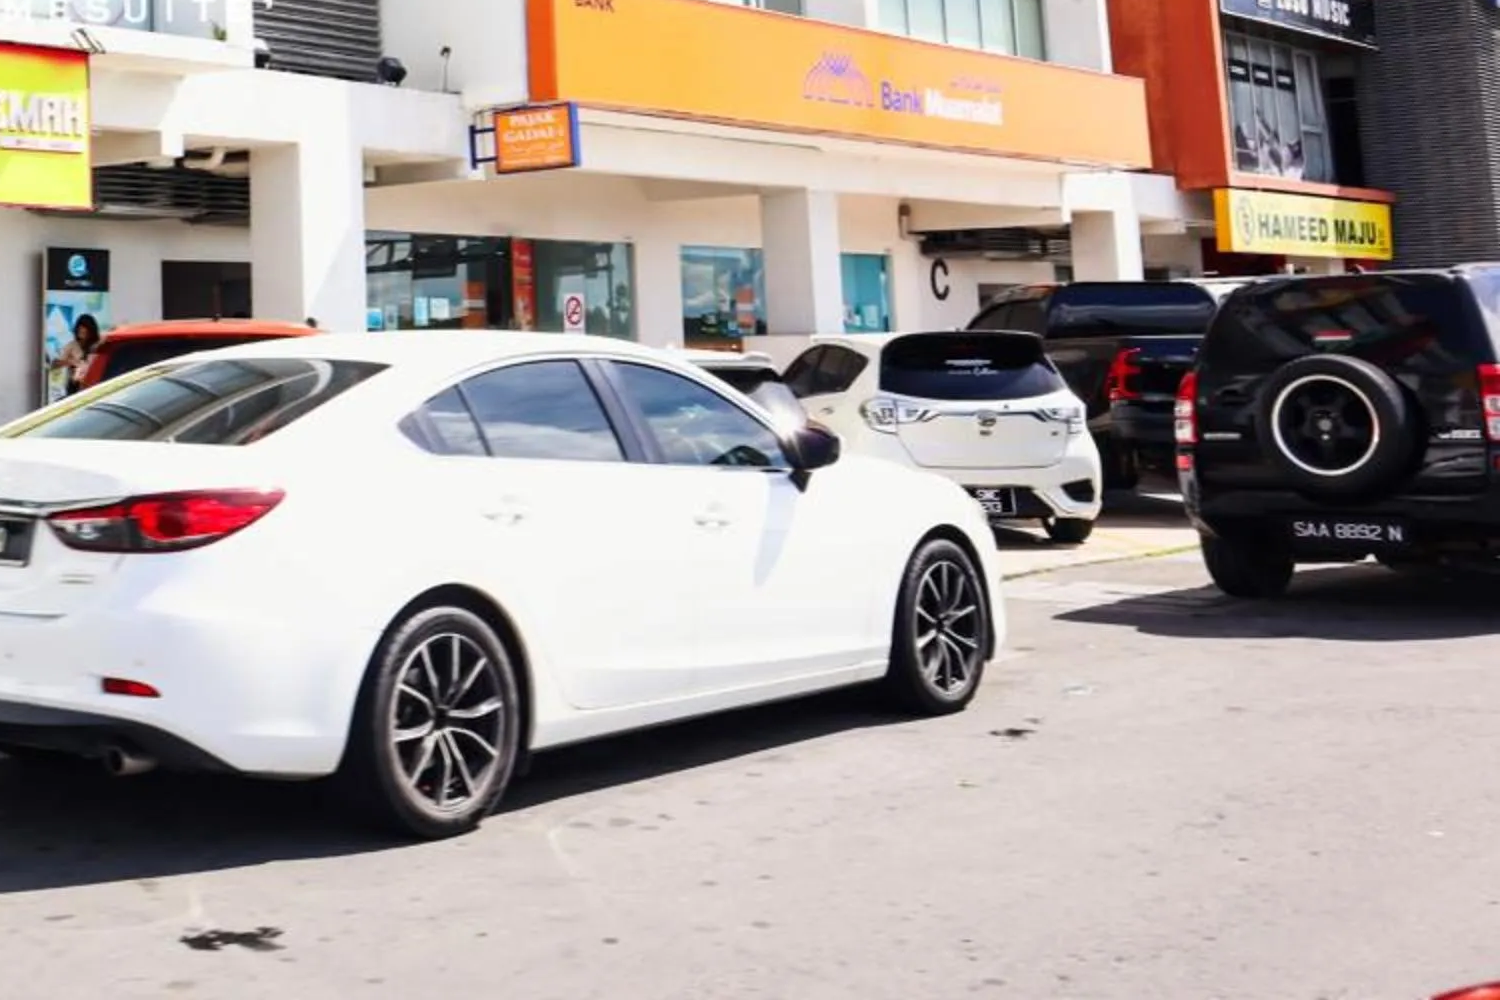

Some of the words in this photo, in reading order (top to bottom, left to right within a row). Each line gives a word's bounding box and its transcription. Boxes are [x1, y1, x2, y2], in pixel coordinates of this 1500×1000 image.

[880, 80, 924, 115] Bank
[1257, 213, 1330, 243] HAMEED
[1334, 218, 1377, 246] MAJU
[930, 258, 951, 302] C
[1292, 520, 1330, 538] SAA
[1386, 524, 1404, 544] N
